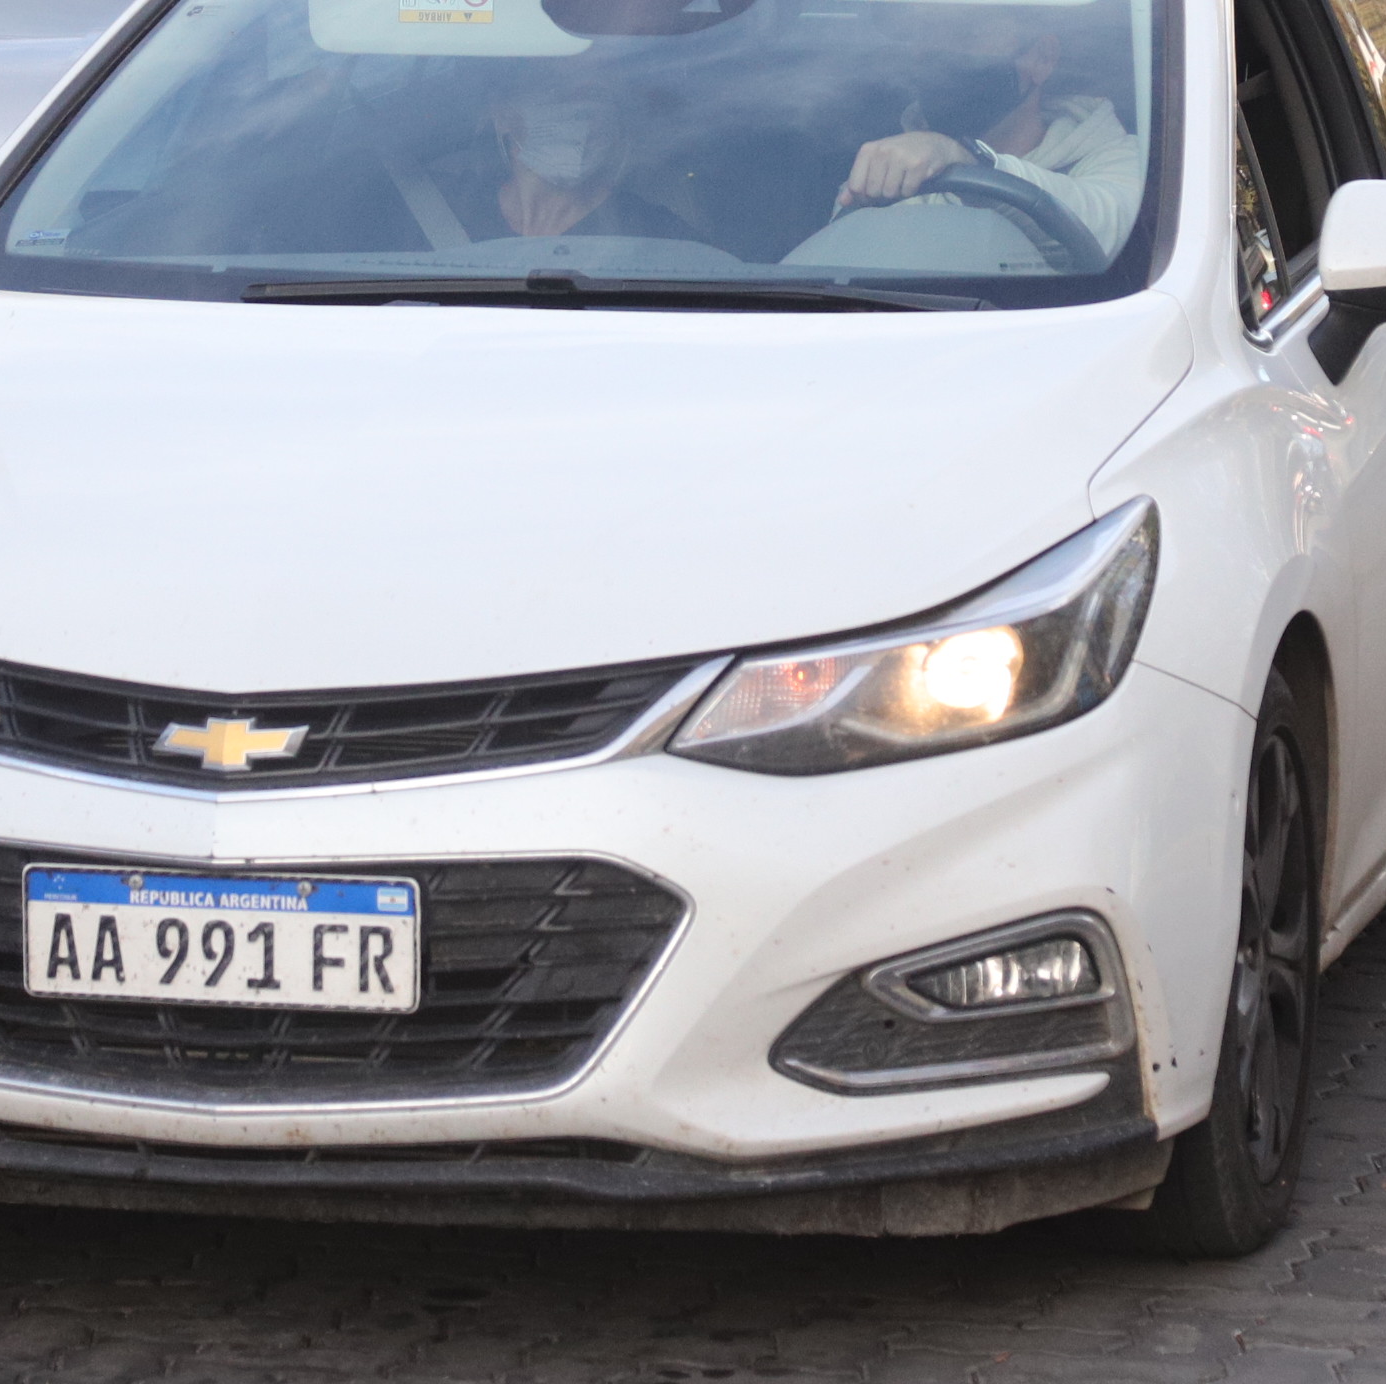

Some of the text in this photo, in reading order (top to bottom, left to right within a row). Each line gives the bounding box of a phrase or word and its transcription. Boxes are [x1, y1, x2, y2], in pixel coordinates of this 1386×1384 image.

[418, 11, 452, 22] AIRBAG
[219, 893, 308, 912] ARGENTINA
[47, 913, 395, 994] AA 991 FR
